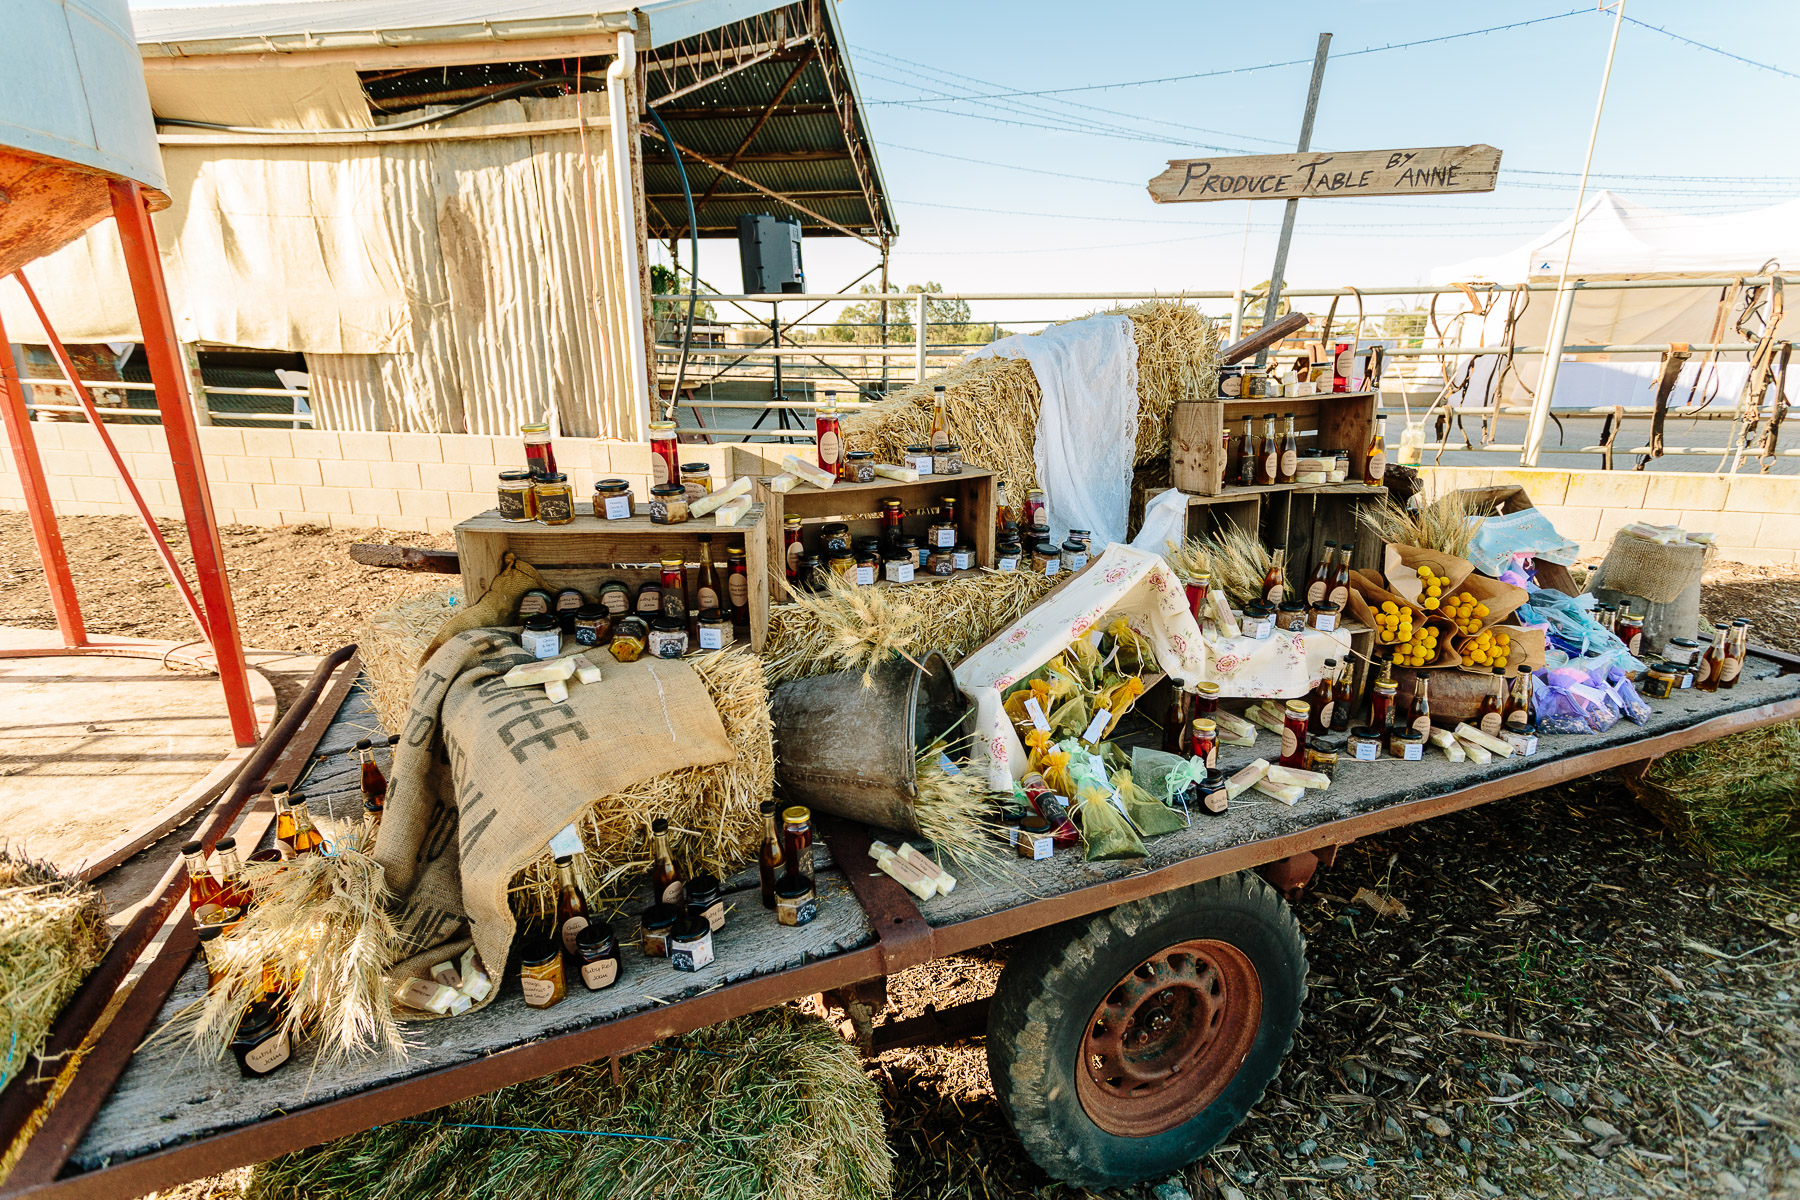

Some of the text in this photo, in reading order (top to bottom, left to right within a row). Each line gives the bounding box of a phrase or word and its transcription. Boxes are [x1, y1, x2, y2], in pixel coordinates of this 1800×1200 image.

[1386, 152, 1418, 169] BY
[1178, 162, 1293, 197] PRODUCE
[1297, 157, 1374, 192] TABLE
[1394, 165, 1462, 188] ANNE
